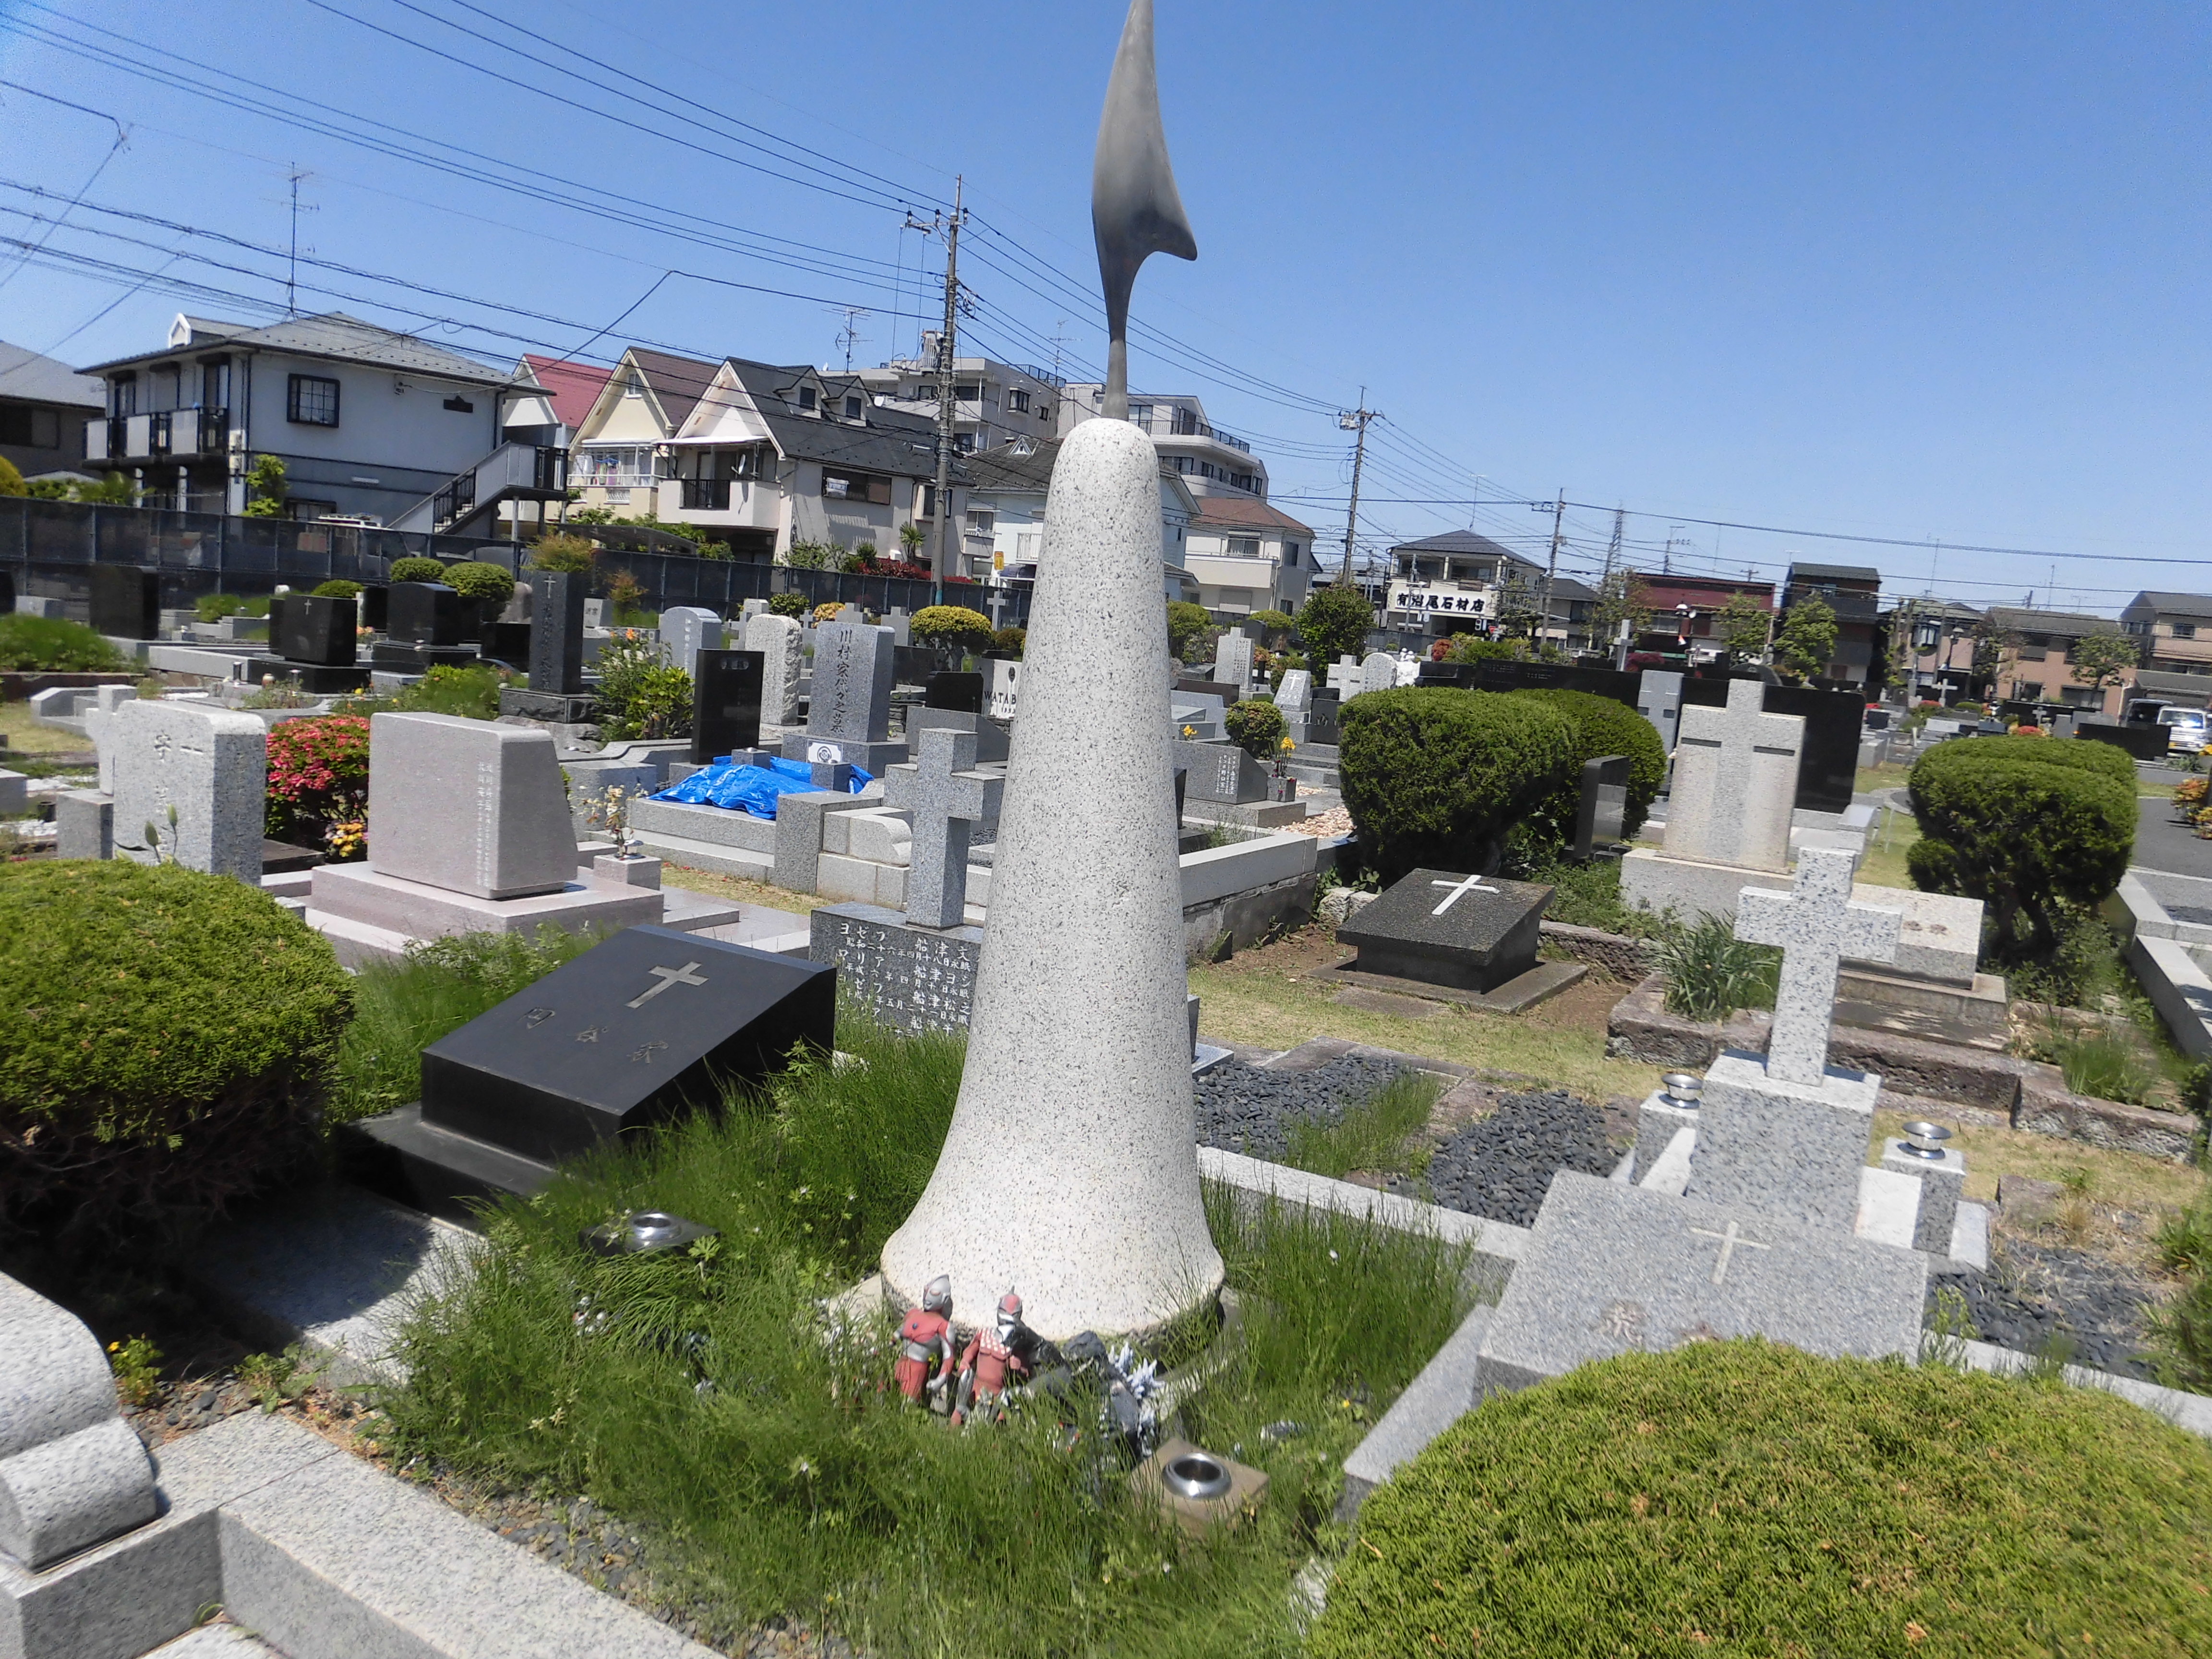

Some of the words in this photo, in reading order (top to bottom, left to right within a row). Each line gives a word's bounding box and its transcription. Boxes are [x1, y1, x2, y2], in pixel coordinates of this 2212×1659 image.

[840, 923, 886, 941] ヨゼフ
[914, 937, 981, 963] 船津文
